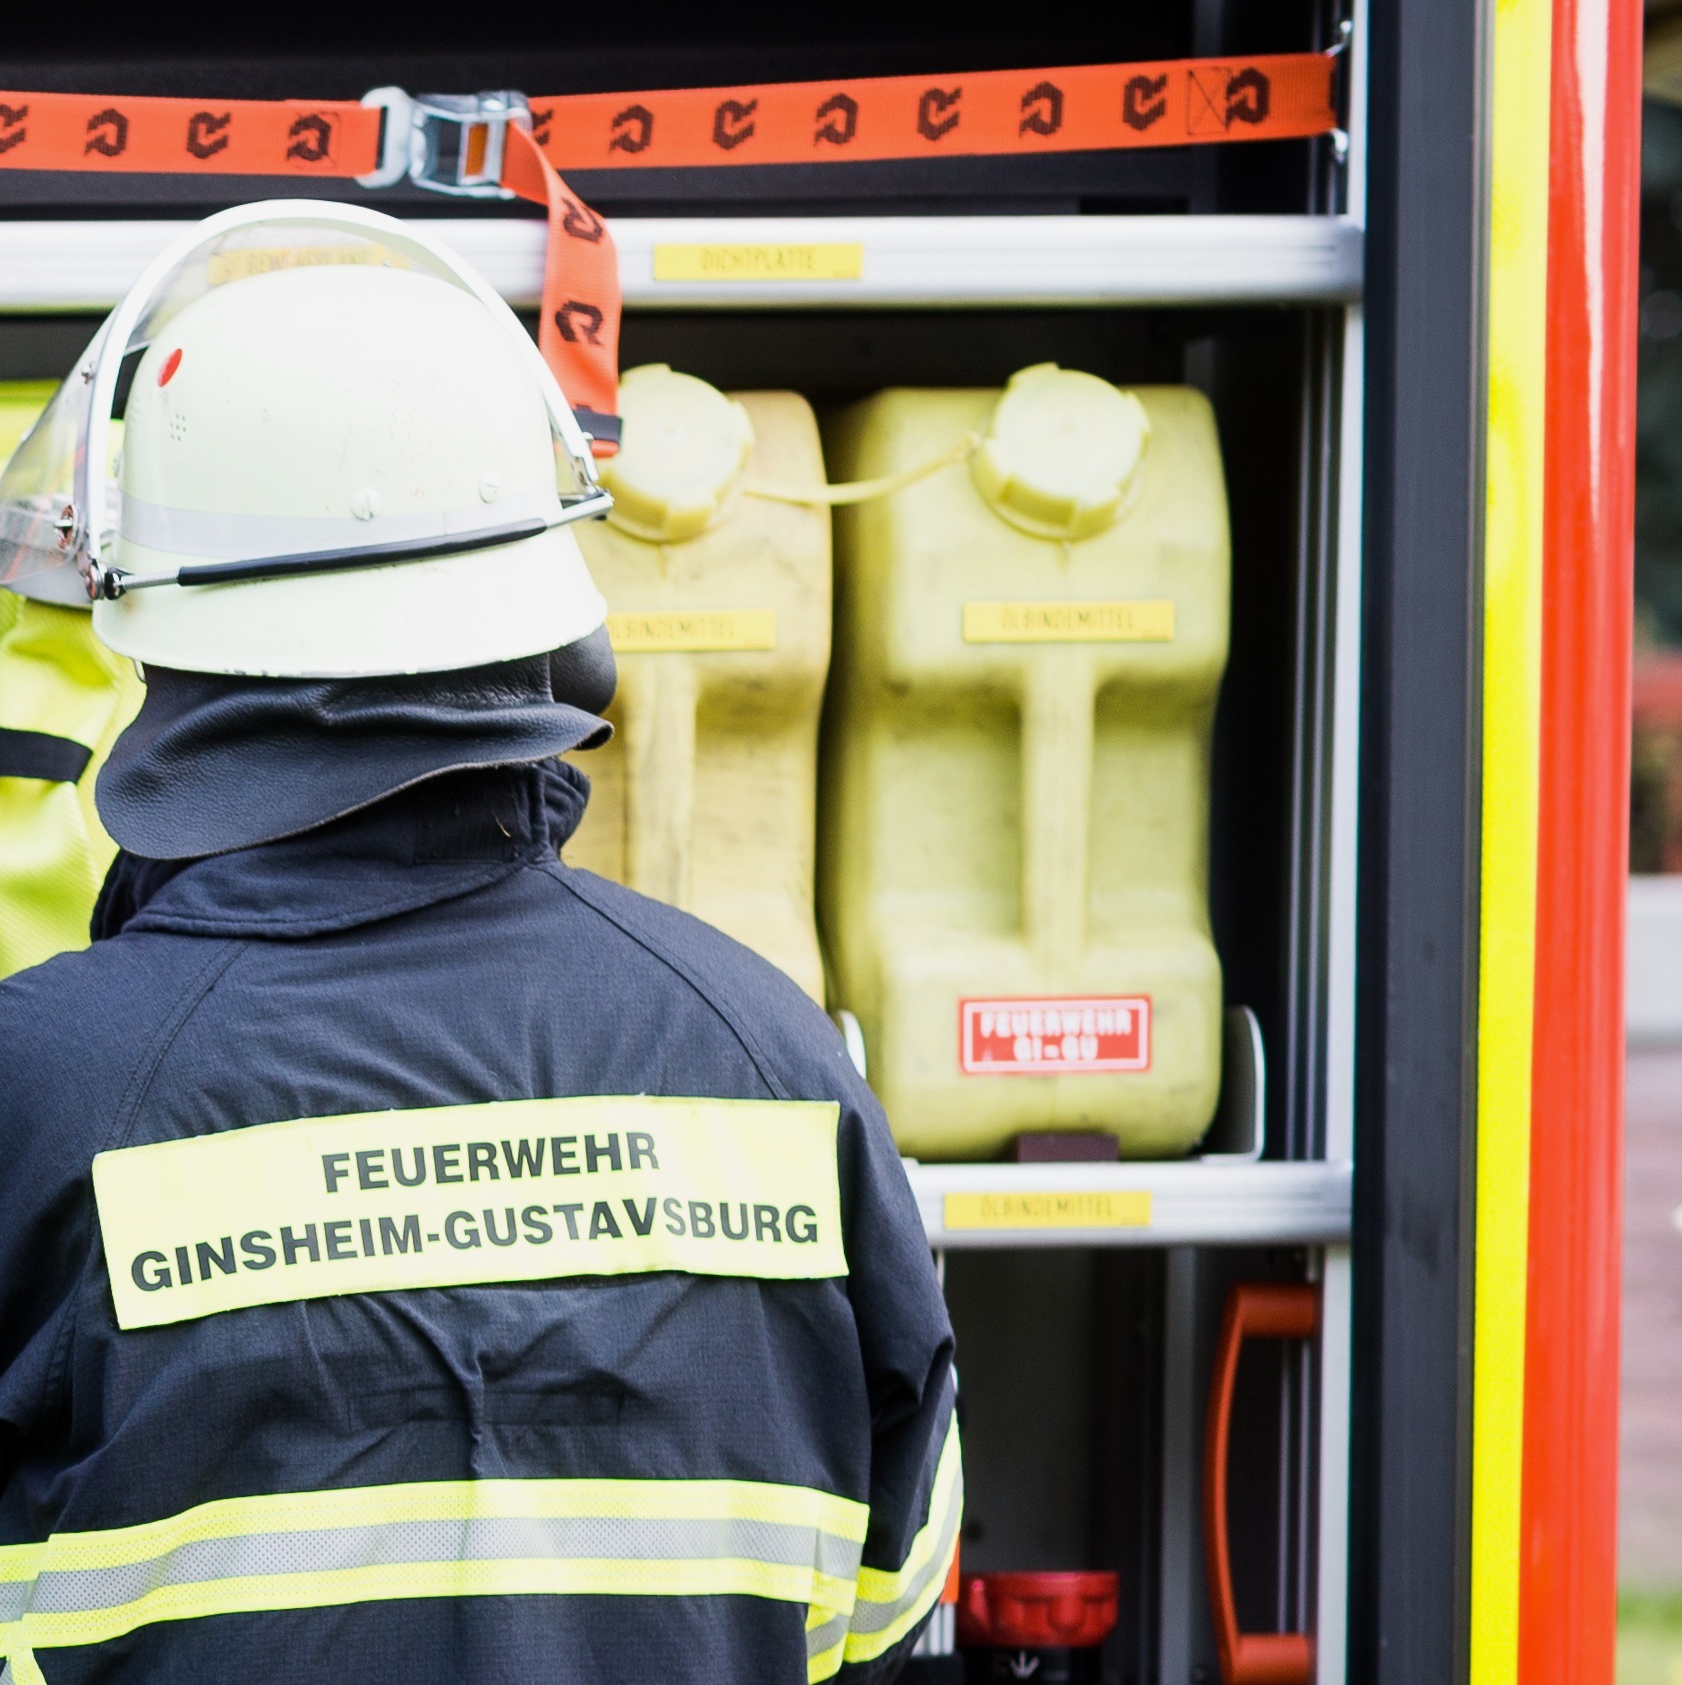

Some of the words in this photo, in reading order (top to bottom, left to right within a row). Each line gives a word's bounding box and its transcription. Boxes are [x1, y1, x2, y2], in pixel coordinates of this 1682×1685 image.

[980, 1008, 1132, 1038] FEUERWEHR
[1013, 1034, 1099, 1062] GI-GU
[321, 1131, 661, 1195] FEUERWEHR
[129, 1196, 819, 1294] GINSHEIM-GUSTAVSBURG
